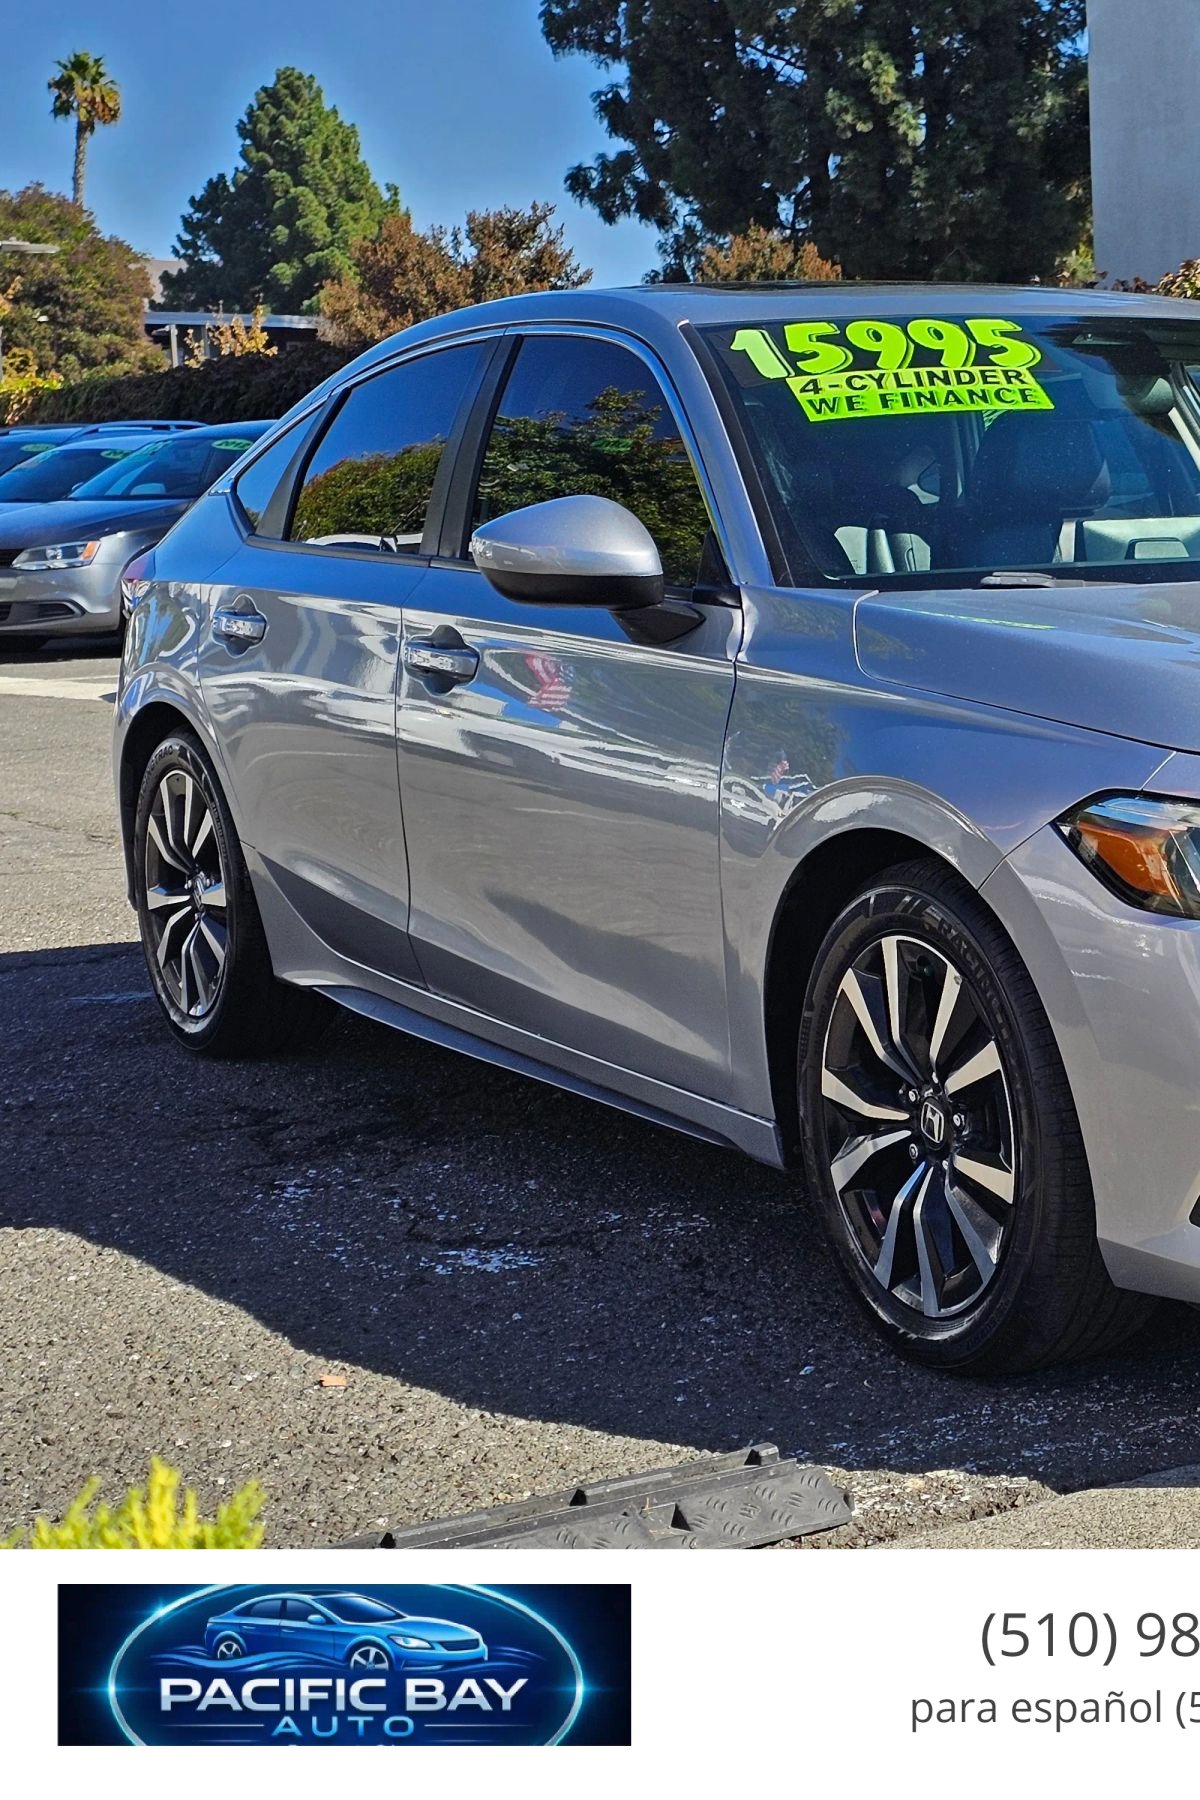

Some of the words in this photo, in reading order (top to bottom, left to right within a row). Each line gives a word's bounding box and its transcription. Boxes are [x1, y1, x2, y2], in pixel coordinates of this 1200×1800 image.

[730, 319, 1042, 379] 15995
[800, 369, 1026, 395] 4-CYLINDER
[806, 394, 866, 415] WE
[879, 387, 1036, 409] FINANCE
